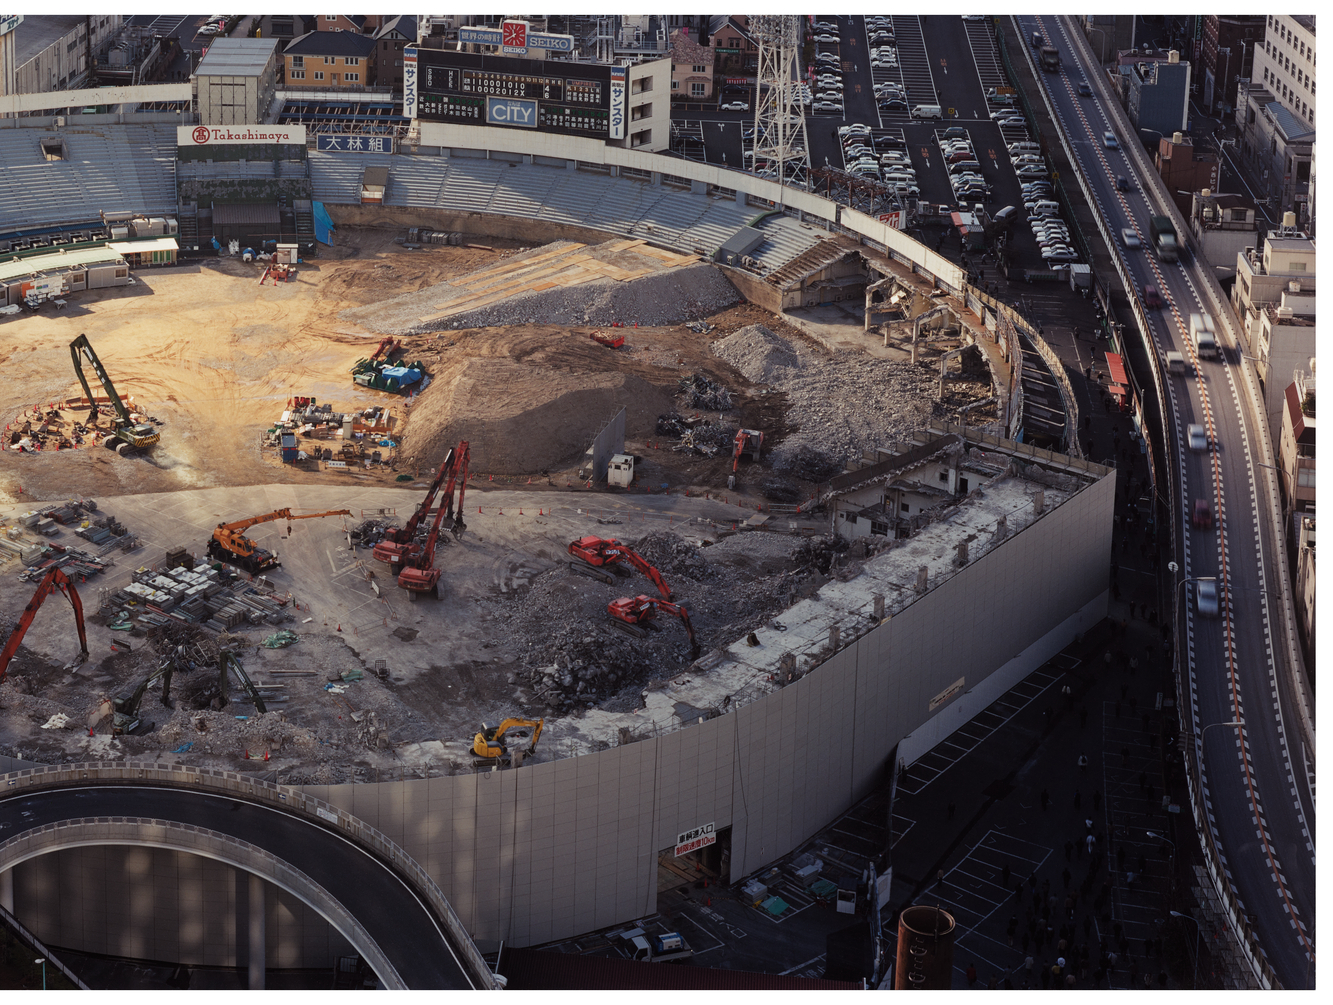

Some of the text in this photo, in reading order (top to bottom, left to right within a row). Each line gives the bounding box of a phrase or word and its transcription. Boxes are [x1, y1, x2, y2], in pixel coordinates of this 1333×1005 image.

[461, 32, 500, 42] 世界の時計
[529, 37, 568, 49] SEIKO
[406, 69, 415, 115] サンスター
[493, 105, 532, 122] CITY
[612, 88, 623, 136] サンスター
[211, 129, 290, 142] Takashimaya
[326, 136, 383, 152] 大林組
